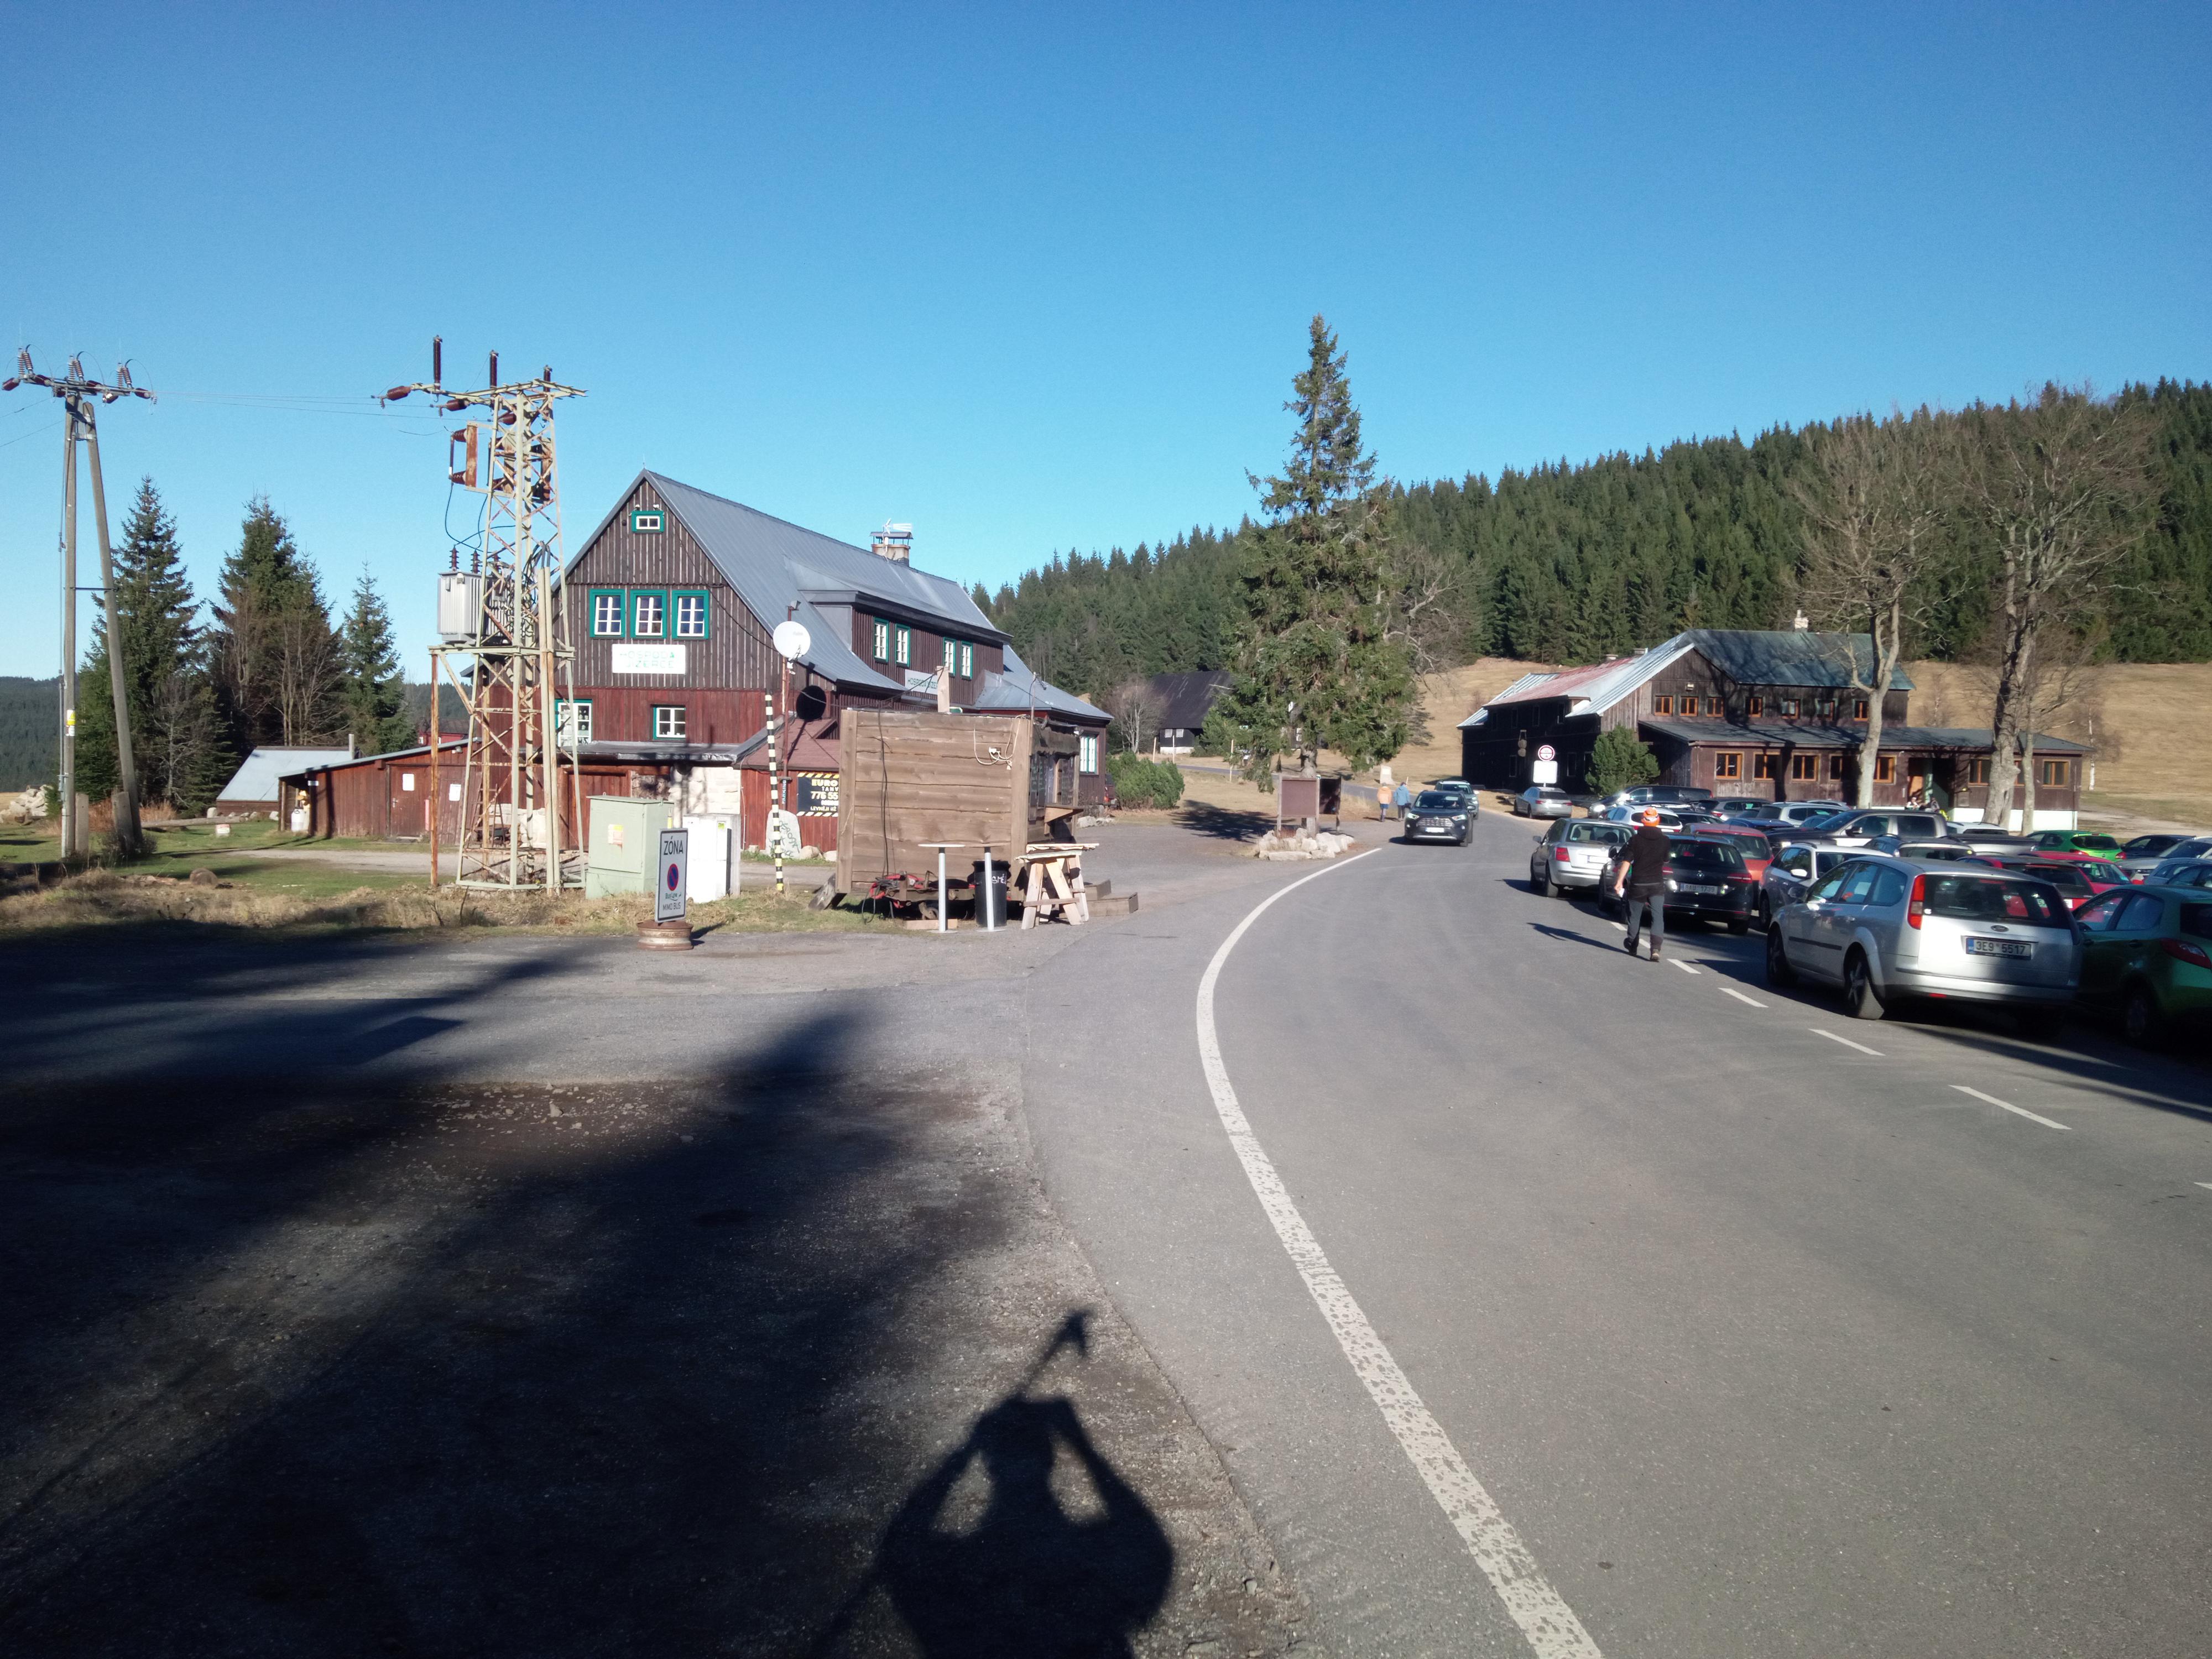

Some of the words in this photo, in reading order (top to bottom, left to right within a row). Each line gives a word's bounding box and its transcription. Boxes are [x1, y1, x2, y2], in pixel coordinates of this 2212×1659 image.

[619, 650, 675, 659] HOSPODA
[811, 779, 838, 787] EURO
[779, 820, 800, 854] OSPODA
[664, 836, 684, 855] ZÓNA
[662, 902, 673, 911] MIMO
[1976, 941, 1994, 952] 3E9
[2001, 943, 2026, 955] 5517
